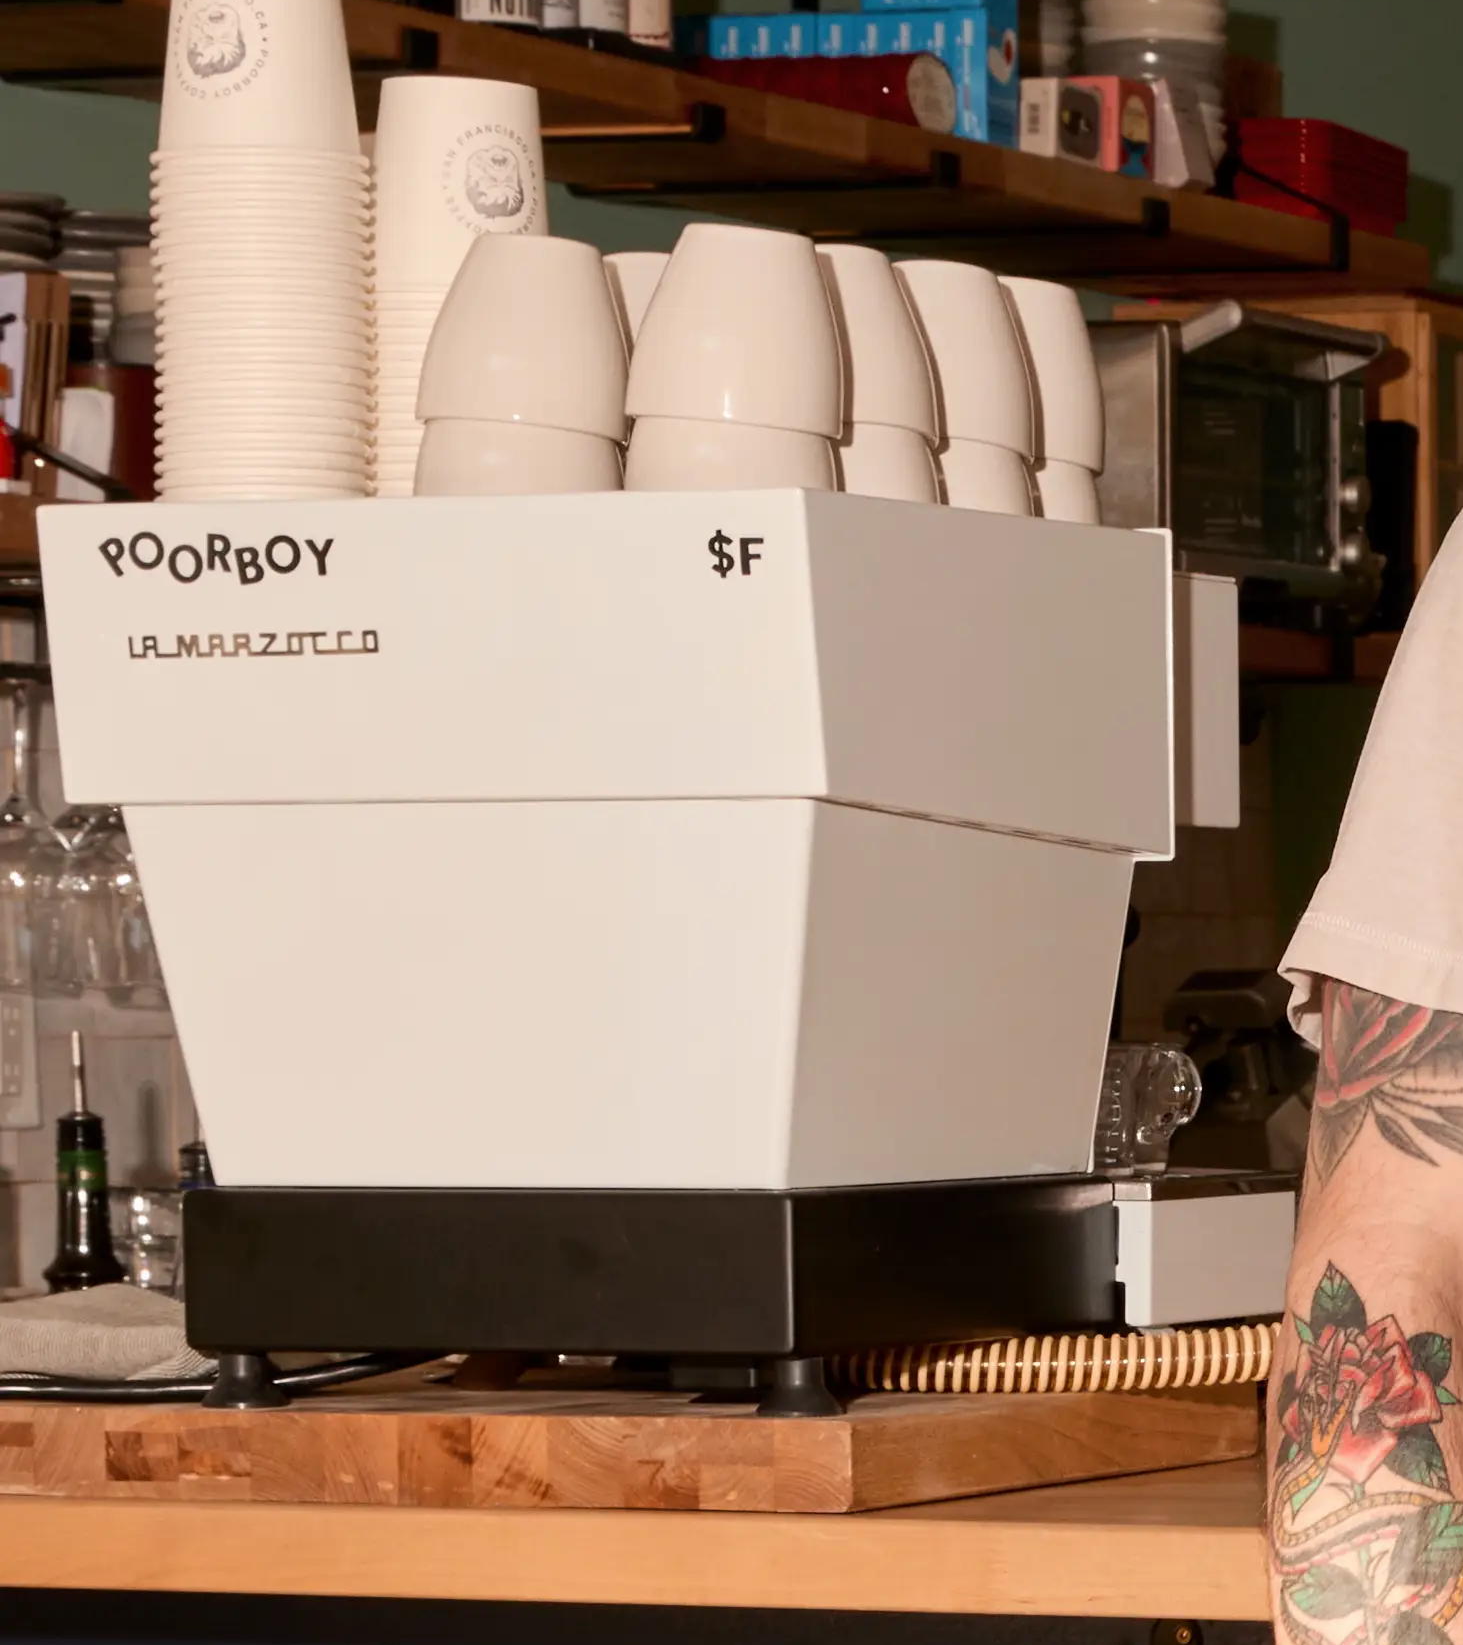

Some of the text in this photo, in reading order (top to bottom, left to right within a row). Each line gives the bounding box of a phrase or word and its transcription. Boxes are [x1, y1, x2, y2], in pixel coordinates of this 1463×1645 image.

[255, 10, 269, 30] CA
[98, 531, 335, 585] POORBOY
[708, 529, 764, 579] $F
